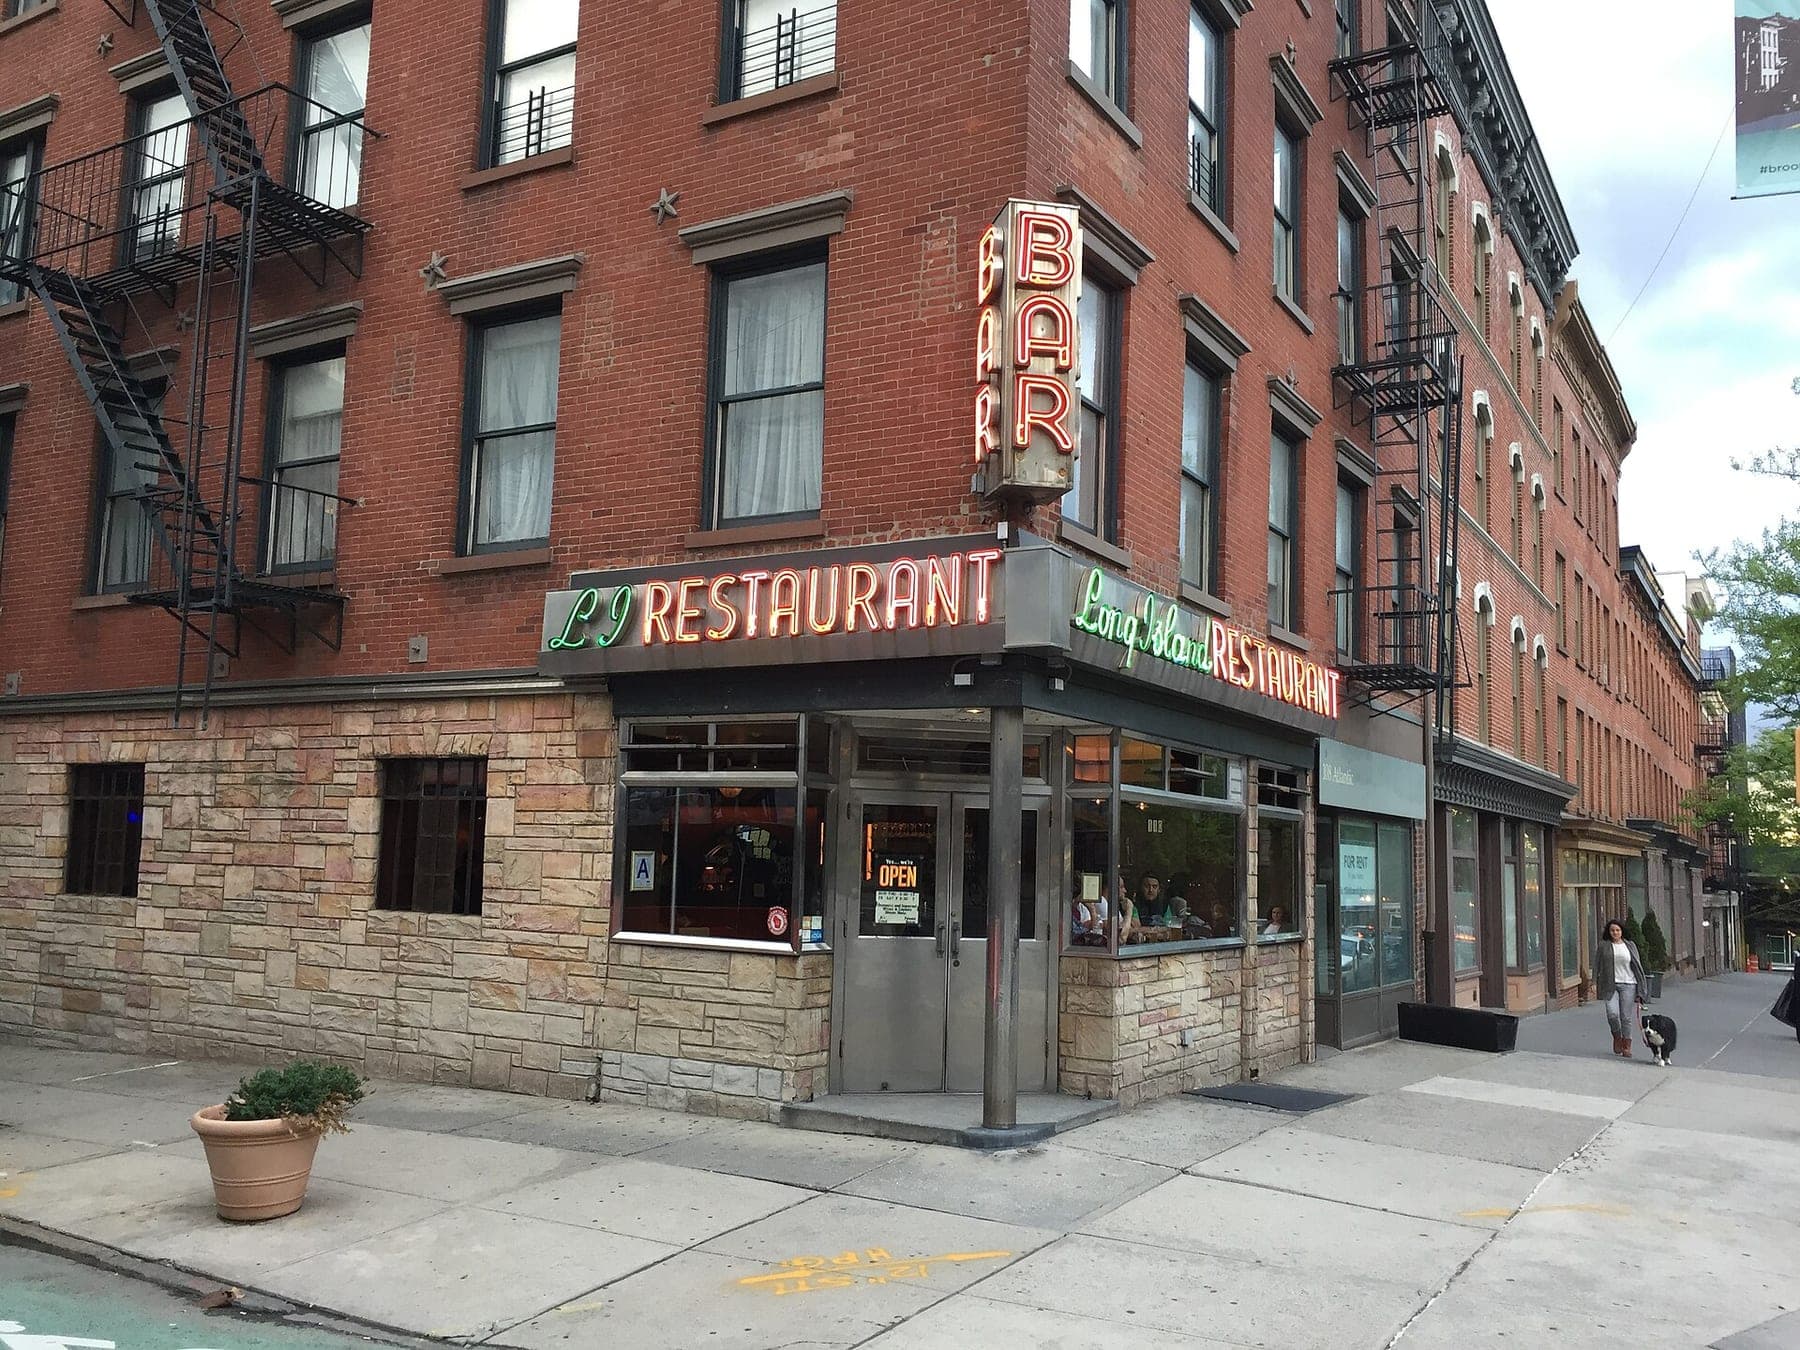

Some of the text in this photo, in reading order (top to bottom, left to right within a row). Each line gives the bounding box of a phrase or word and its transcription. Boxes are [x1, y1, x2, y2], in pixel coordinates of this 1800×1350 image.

[1760, 163, 1800, 174] #broo
[975, 224, 1000, 464] BAR
[1013, 211, 1075, 454] BAR
[549, 549, 1003, 650] LI RESTAURANT
[1075, 566, 1341, 719] Long Island RESTAURANT
[636, 858, 649, 879] A
[879, 865, 917, 887] OPEN
[1343, 855, 1355, 869] FOR
